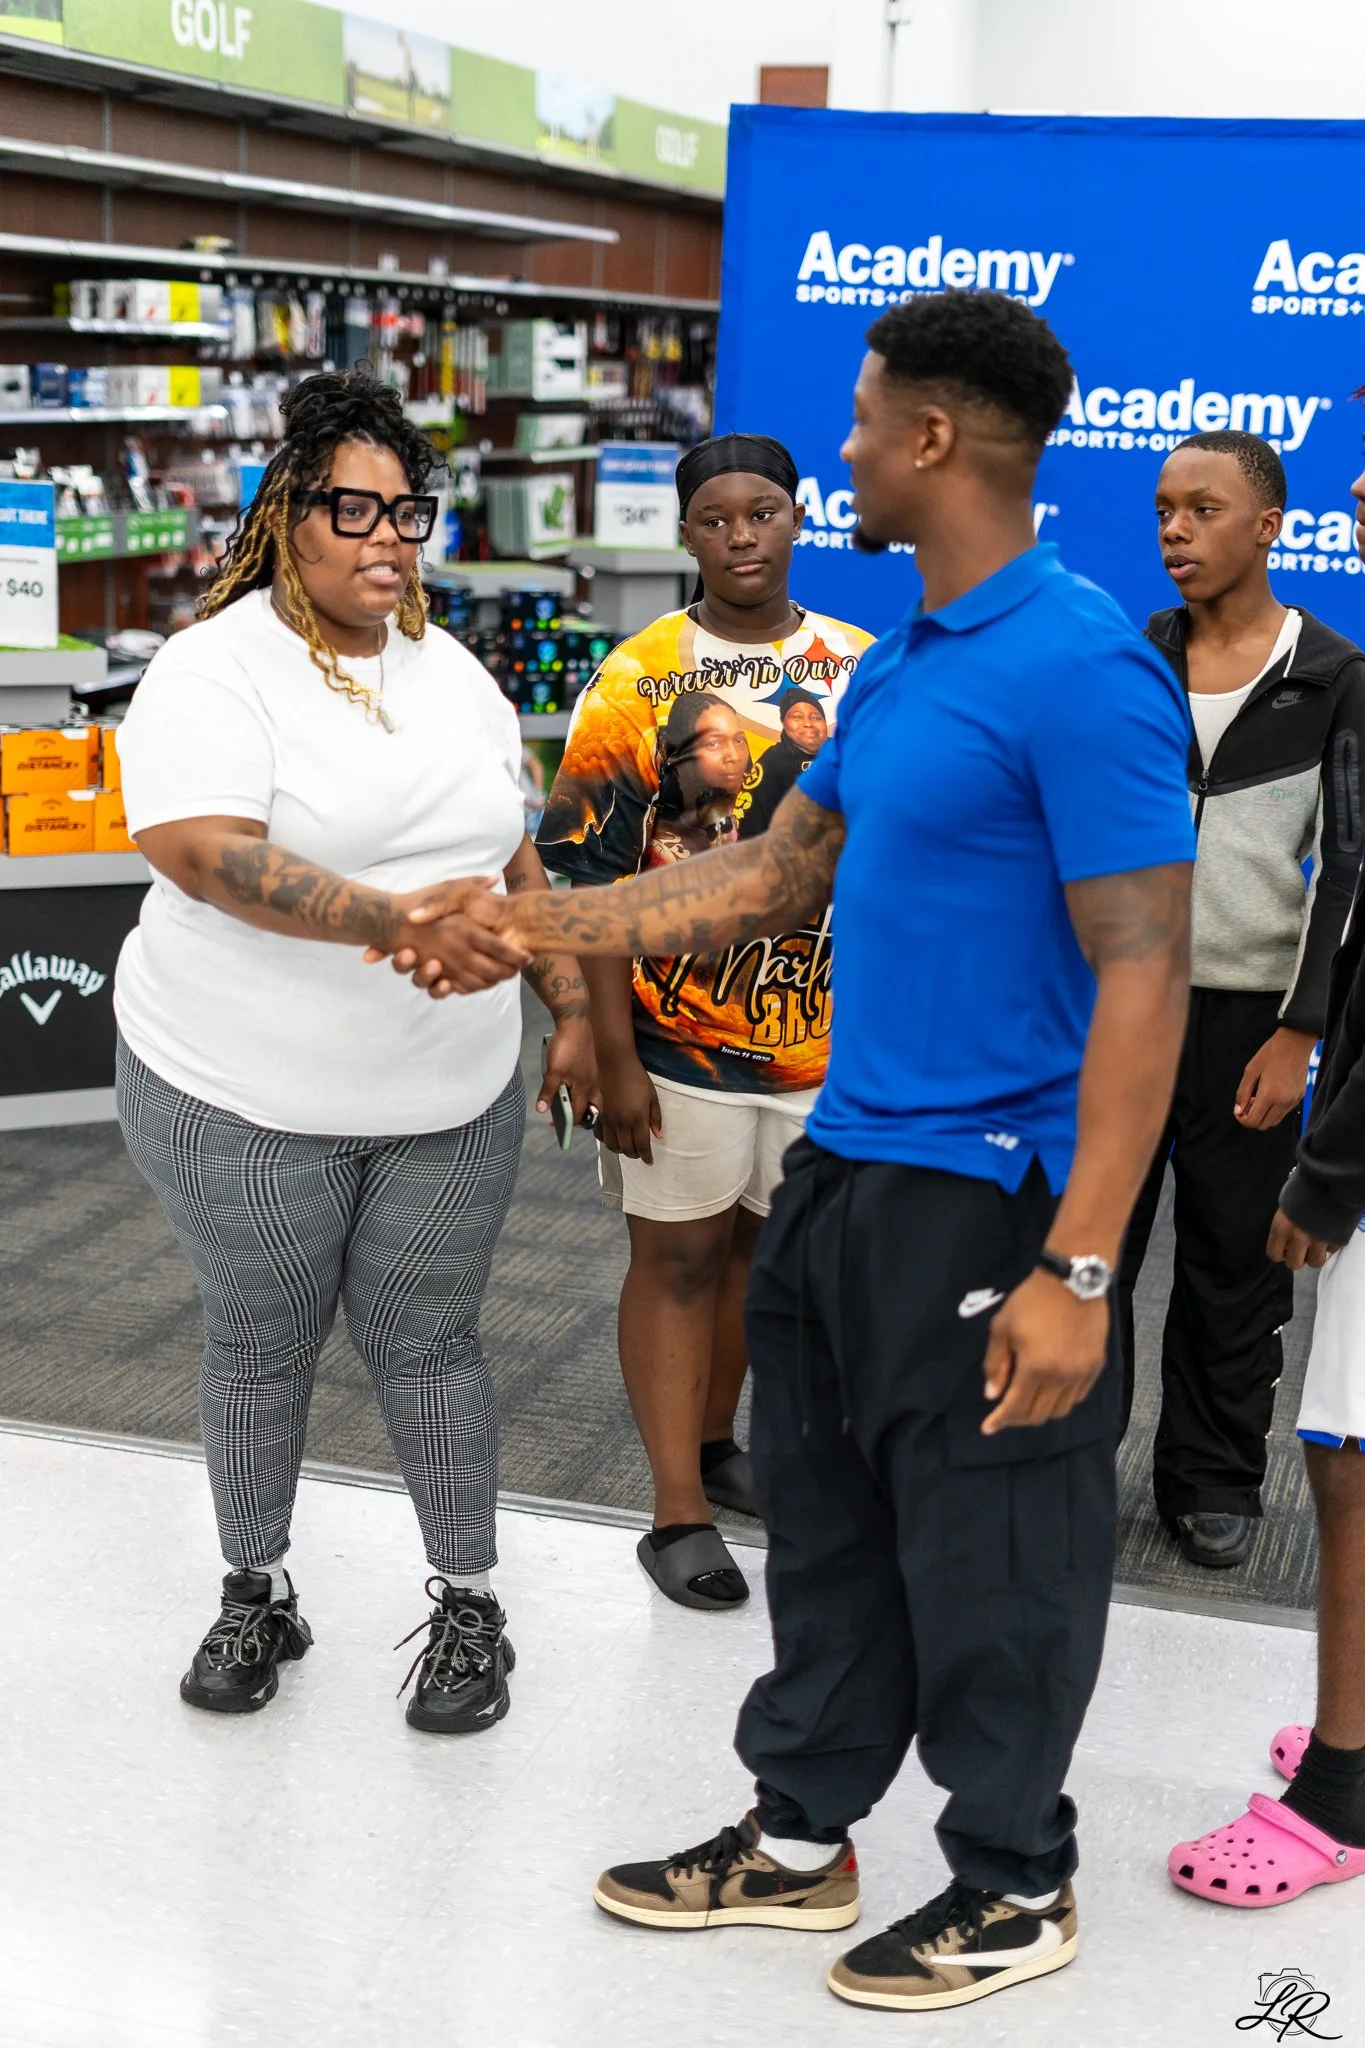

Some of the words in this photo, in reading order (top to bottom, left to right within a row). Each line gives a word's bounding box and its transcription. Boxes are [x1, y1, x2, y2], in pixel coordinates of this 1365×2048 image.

[170, 0, 253, 60] GOLF
[656, 125, 700, 169] GOLF
[7, 579, 43, 598] $40
[637, 668, 738, 708] Forever
[740, 658, 781, 689] In
[785, 655, 839, 684] Our
[0, 950, 106, 998] allaway
